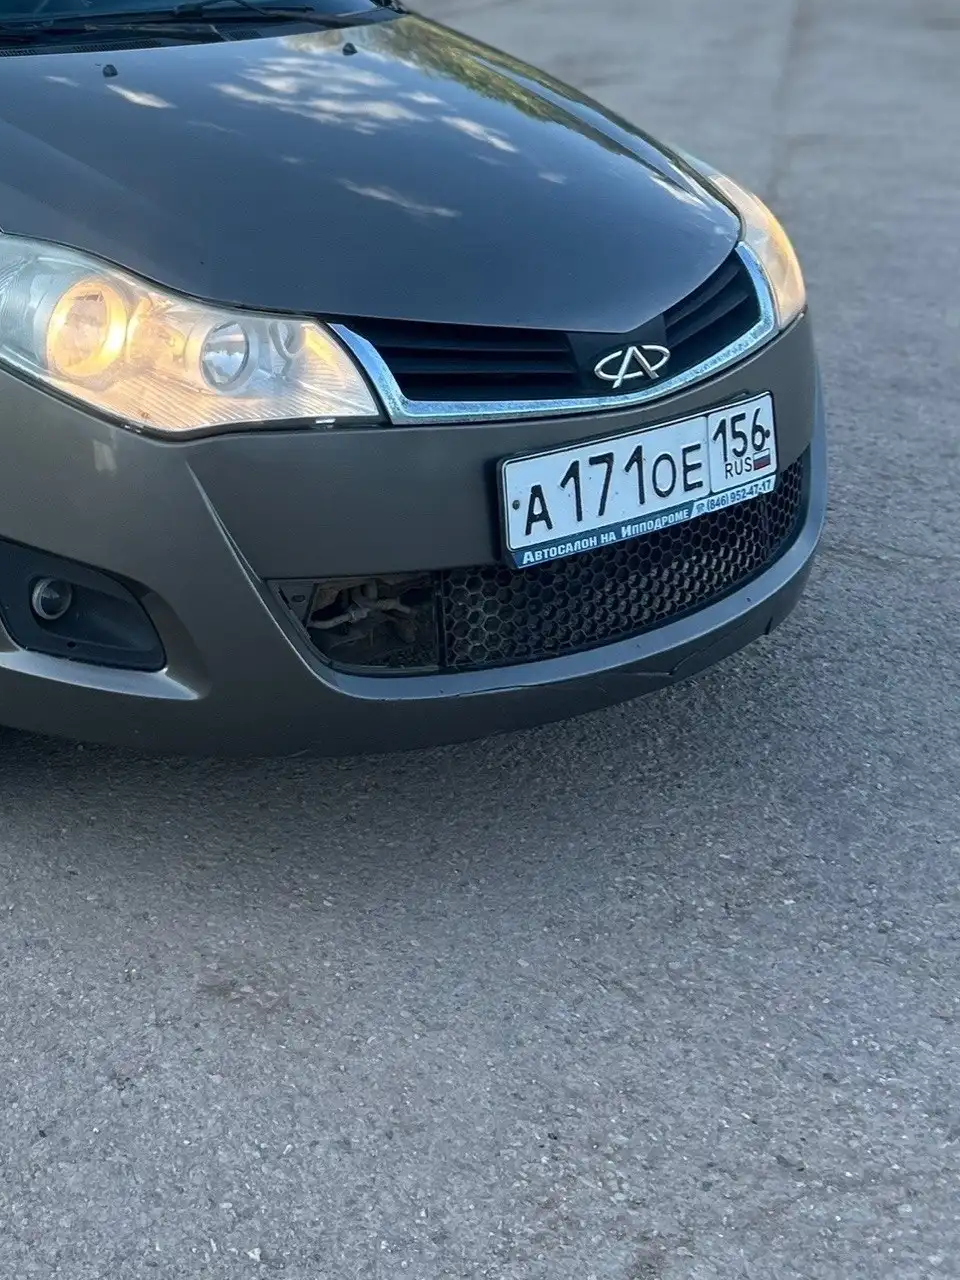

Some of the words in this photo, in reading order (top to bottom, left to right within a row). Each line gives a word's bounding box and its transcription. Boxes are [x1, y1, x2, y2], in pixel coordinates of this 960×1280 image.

[712, 407, 766, 462] 156
[525, 443, 704, 536] А171ОЕ
[724, 456, 753, 480] RUS
